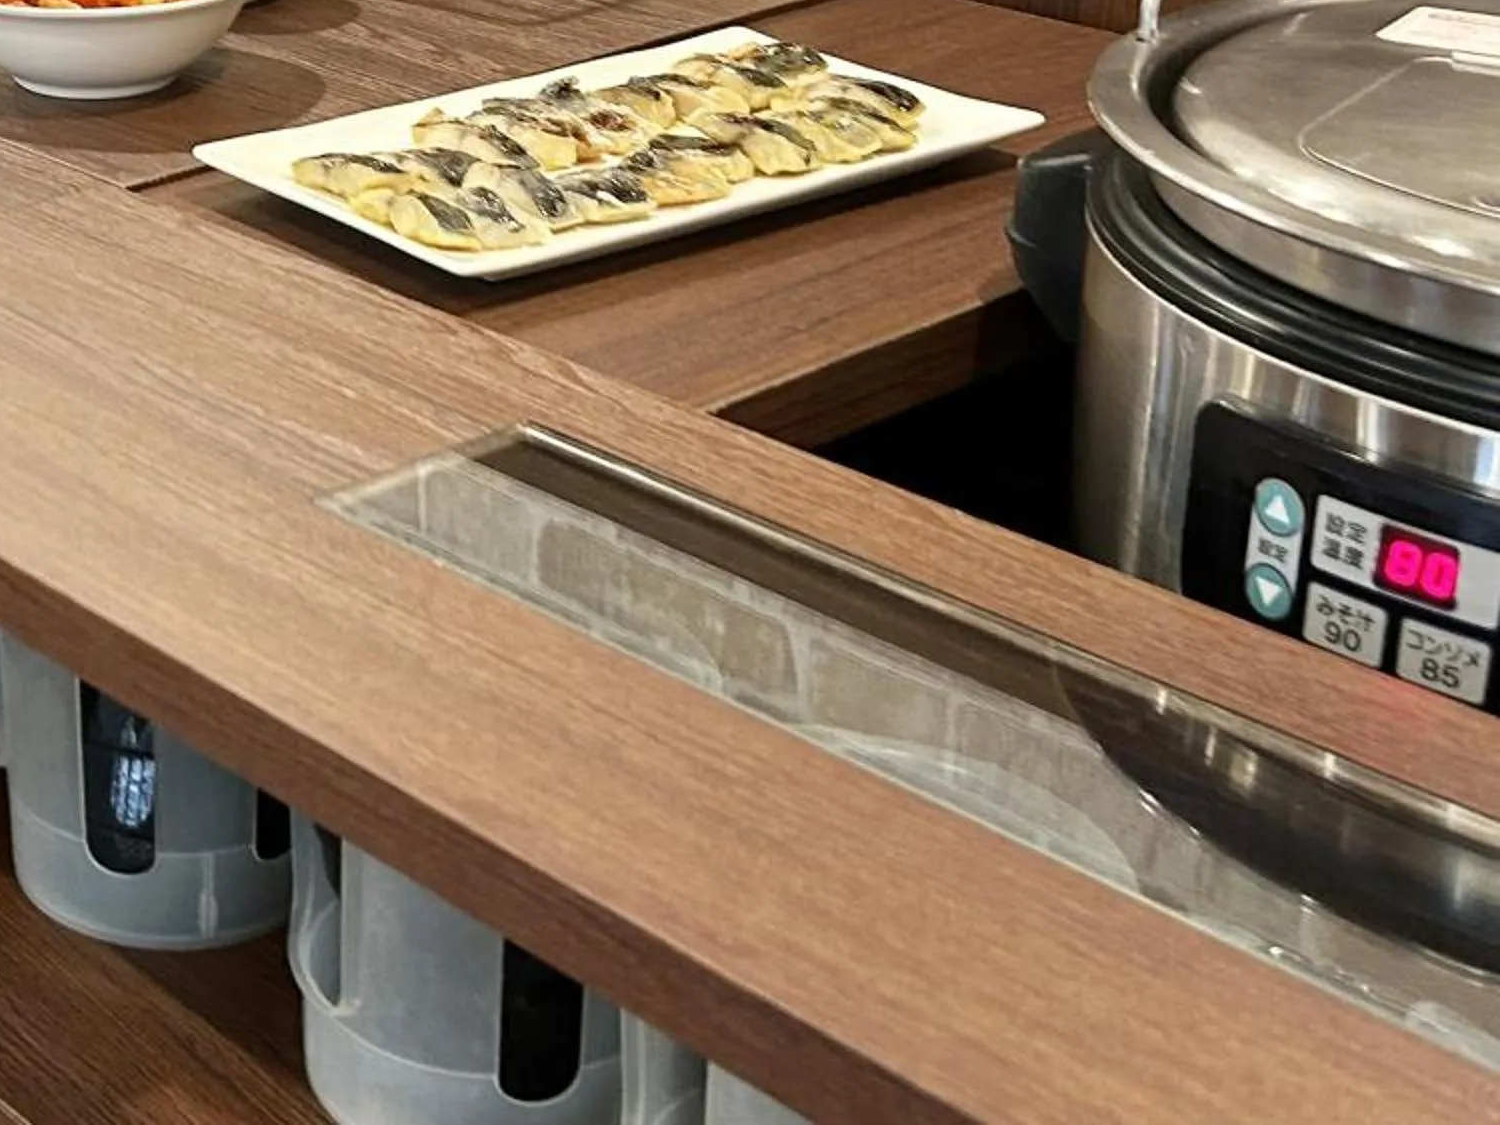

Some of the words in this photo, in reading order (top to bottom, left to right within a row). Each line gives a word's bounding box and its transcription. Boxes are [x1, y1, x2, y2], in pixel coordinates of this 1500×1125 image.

[1384, 540, 1458, 598] 80
[1316, 594, 1376, 632] みそ汁
[1324, 621, 1361, 652] 90
[1405, 628, 1481, 668] コンソメ
[1420, 658, 1461, 688] 85
